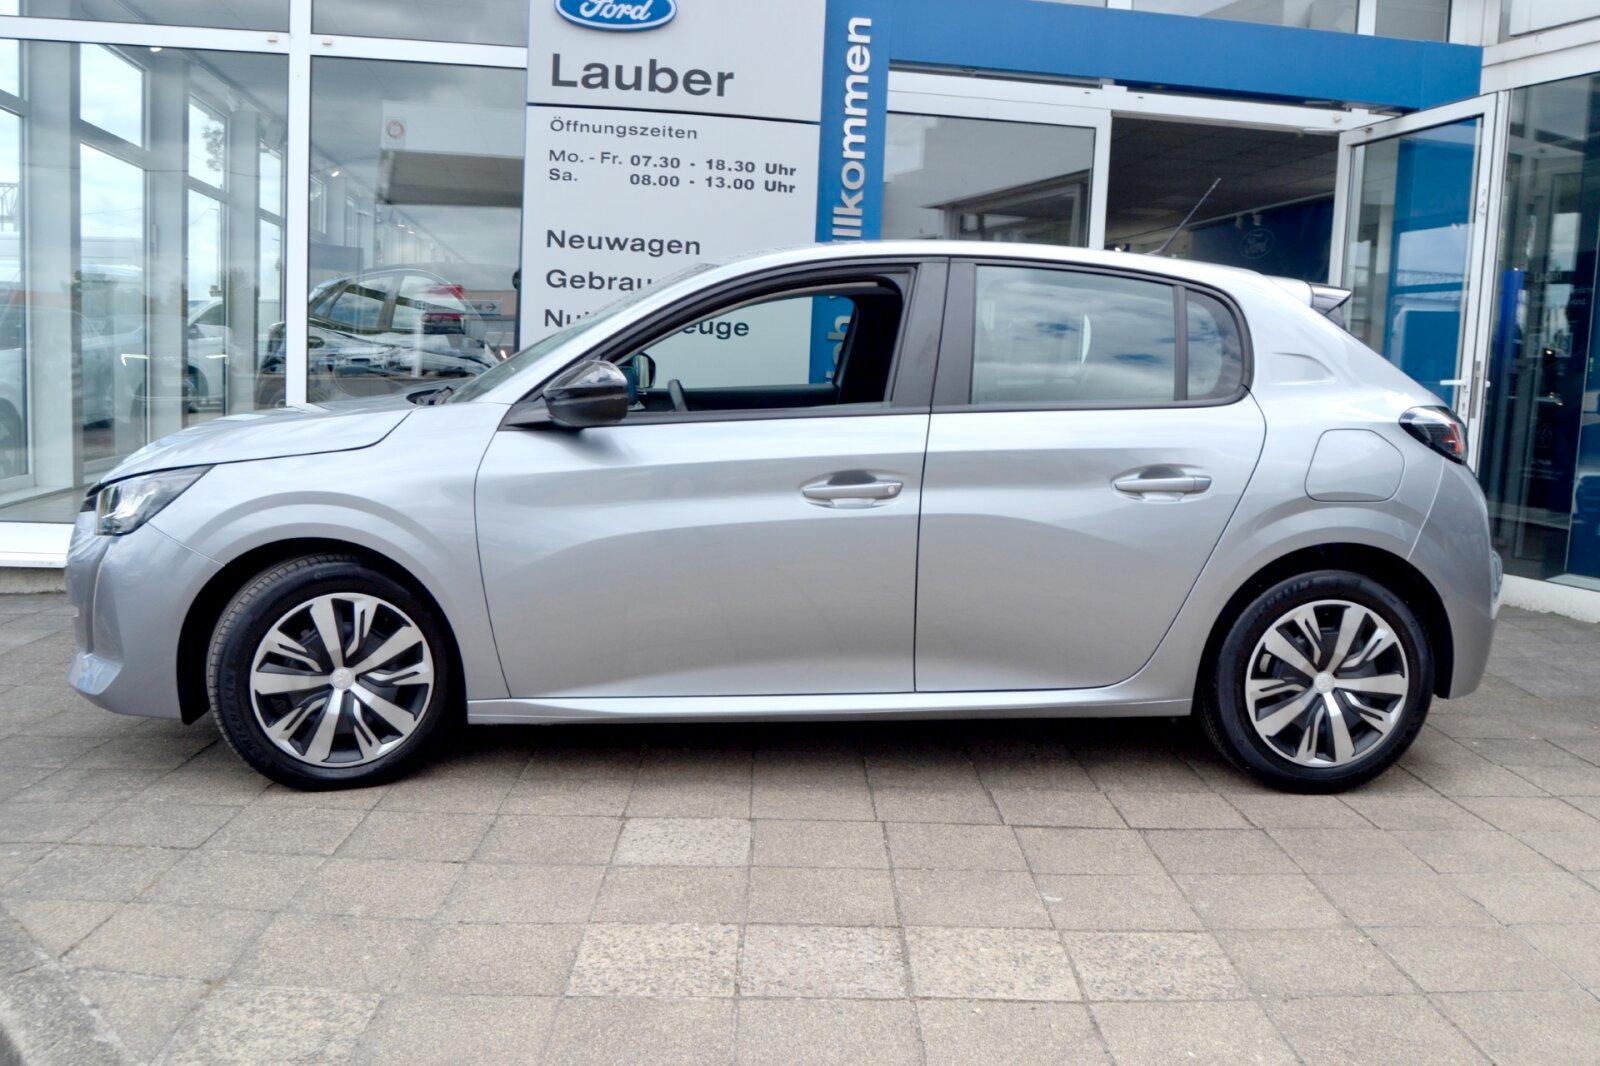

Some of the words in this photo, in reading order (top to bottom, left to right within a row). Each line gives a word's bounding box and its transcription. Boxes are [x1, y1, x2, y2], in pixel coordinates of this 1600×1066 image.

[579, 0, 651, 21] Ford
[552, 53, 734, 97] Lauber
[550, 116, 698, 139] Öffnungszeiten
[549, 150, 584, 163] Mo.
[600, 152, 622, 165] Fr.
[630, 155, 681, 169] 07.30
[706, 159, 756, 173] 18.30
[765, 162, 797, 176] Uhr
[549, 168, 578, 182] Sa.
[630, 174, 680, 187] 08.00
[705, 176, 755, 190] 13.00
[764, 180, 796, 194] Uhr
[547, 229, 701, 257] Neuwagen
